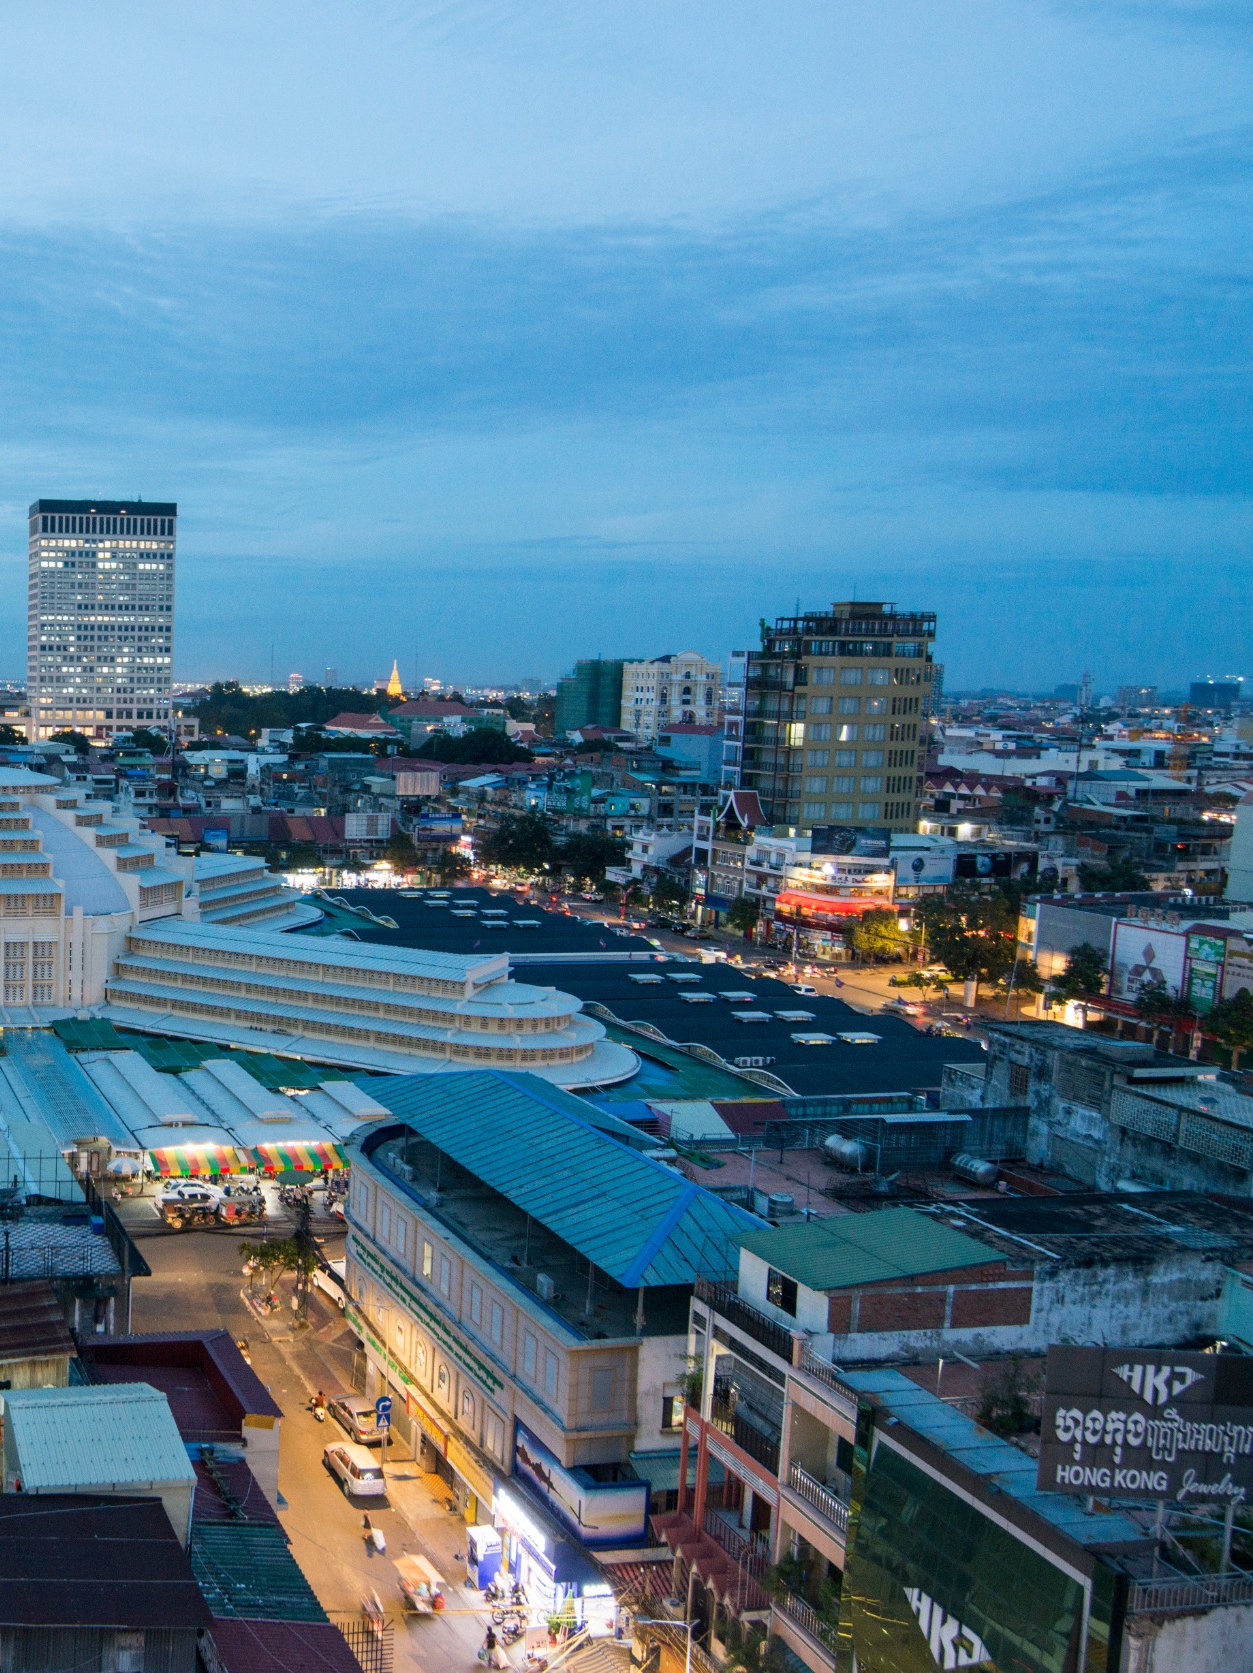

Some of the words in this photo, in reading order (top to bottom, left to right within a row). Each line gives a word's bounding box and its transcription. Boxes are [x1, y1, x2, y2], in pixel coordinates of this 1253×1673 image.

[1111, 1364, 1205, 1406] HKJ
[1056, 1464, 1111, 1488] HONG
[1114, 1468, 1168, 1491] KONG
[1177, 1468, 1246, 1505] Jewelry
